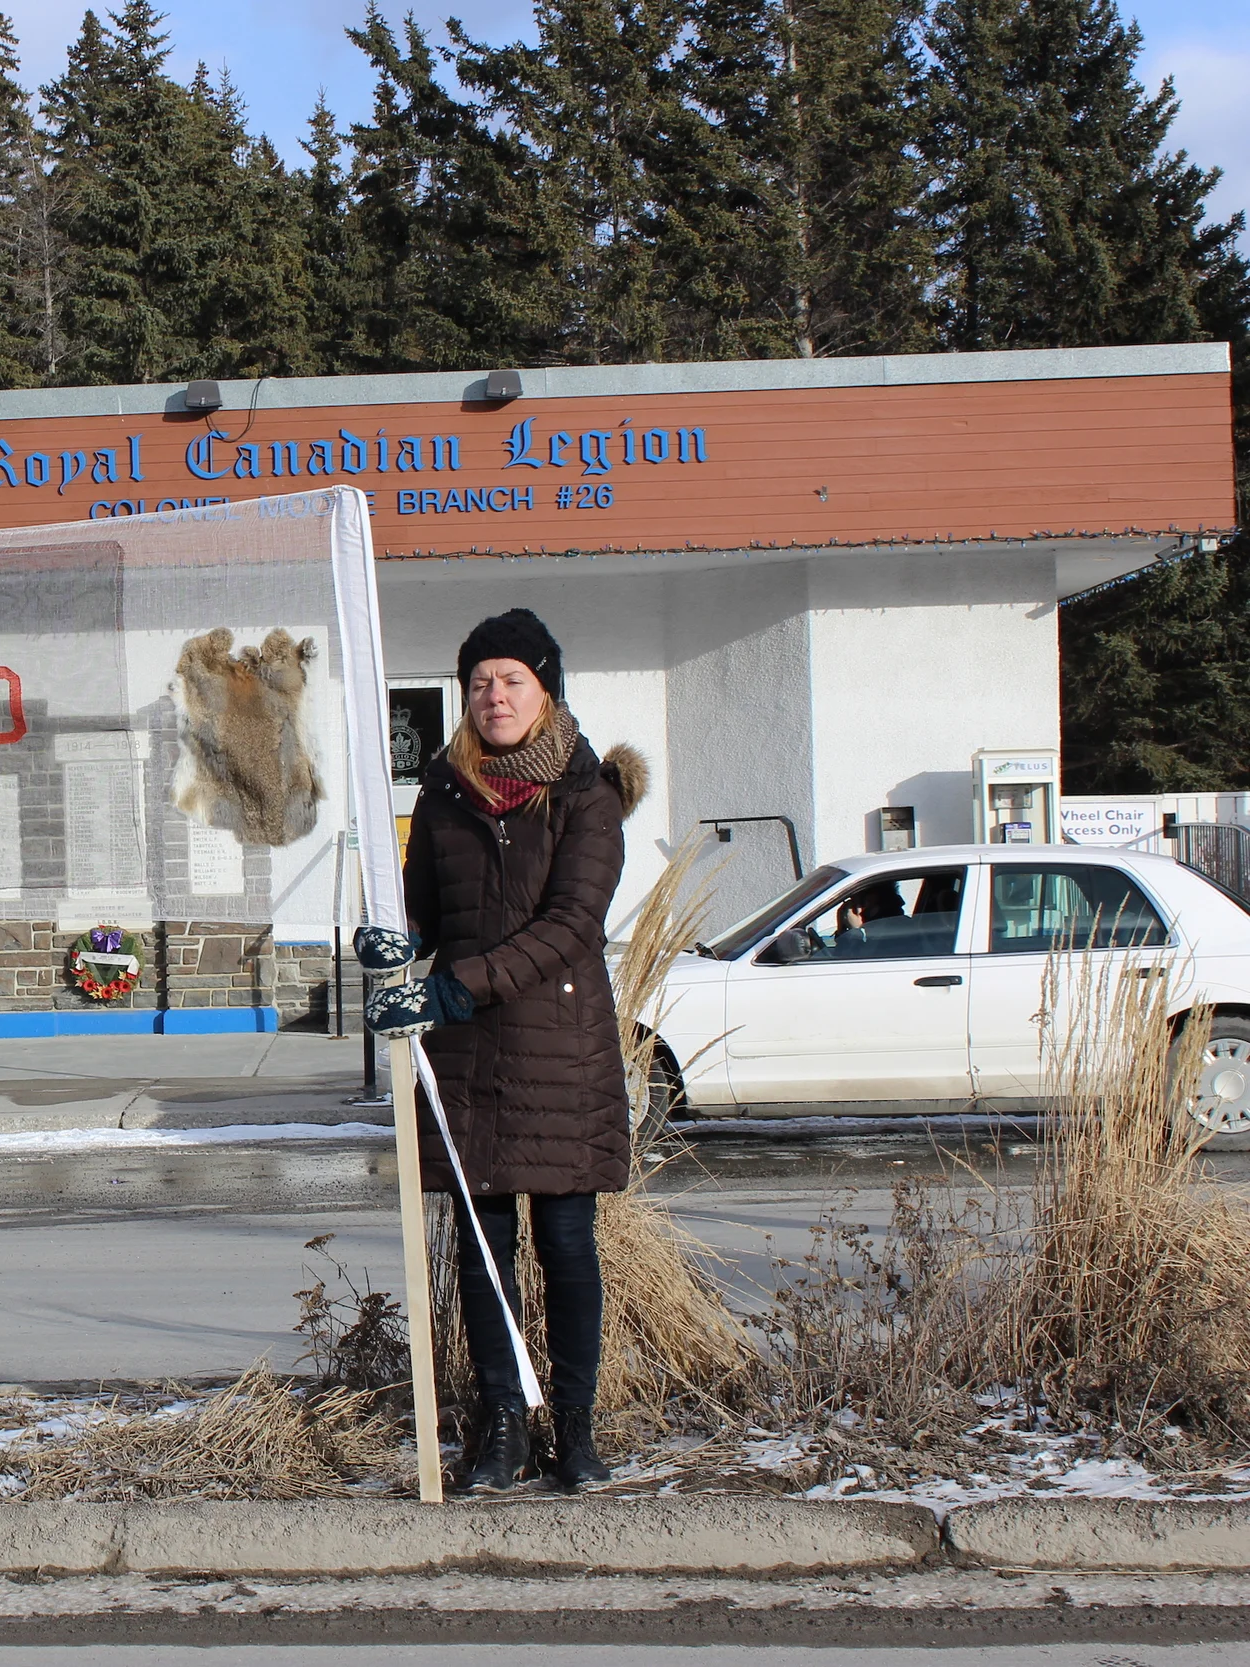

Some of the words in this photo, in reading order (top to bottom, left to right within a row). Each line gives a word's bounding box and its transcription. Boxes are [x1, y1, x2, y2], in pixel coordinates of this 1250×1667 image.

[186, 427, 462, 480] Canadian
[503, 416, 709, 476] Legion
[89, 497, 242, 523] COLONEL
[258, 490, 376, 521] MOOE
[398, 486, 534, 516] BRANCH
[556, 483, 614, 510] #26
[1014, 762, 1048, 771] TELUS
[1105, 809, 1144, 821] Chair
[1062, 826, 1104, 836] ccess
[1108, 824, 1142, 837] Only
